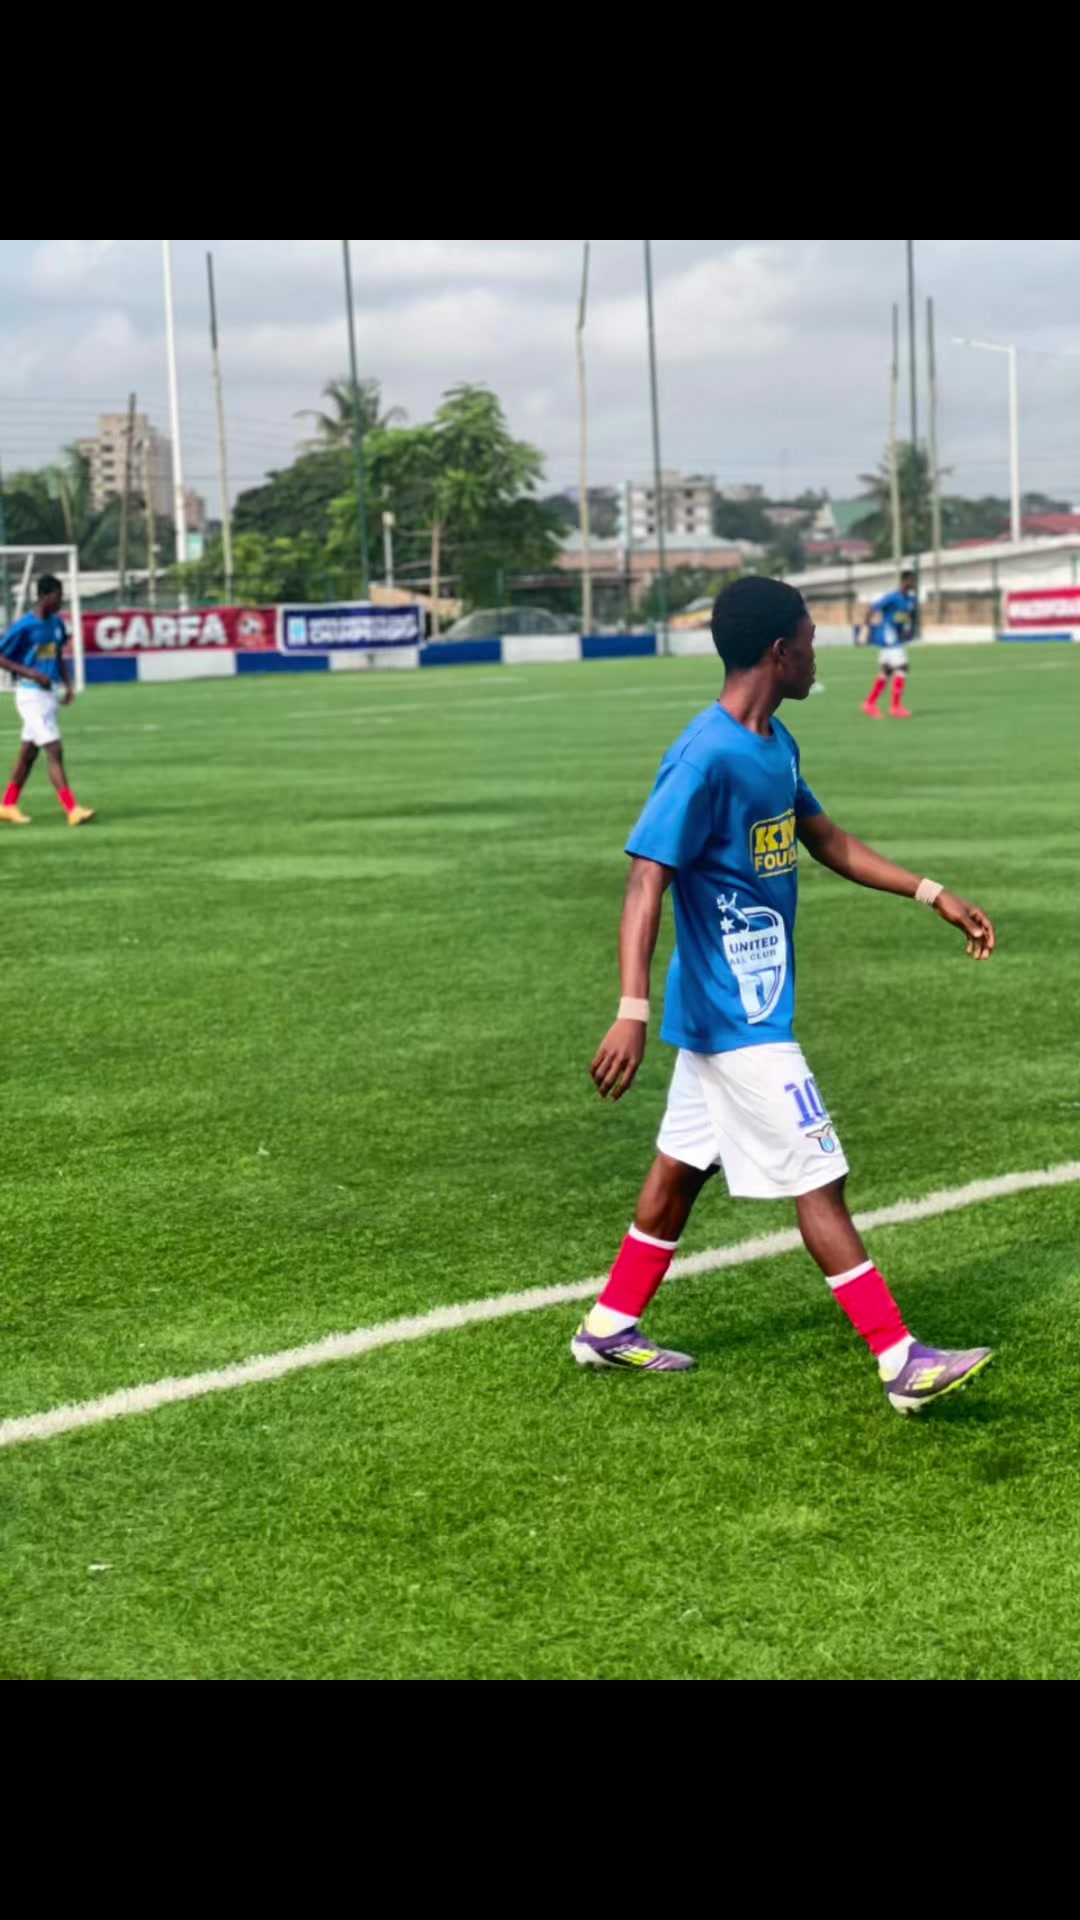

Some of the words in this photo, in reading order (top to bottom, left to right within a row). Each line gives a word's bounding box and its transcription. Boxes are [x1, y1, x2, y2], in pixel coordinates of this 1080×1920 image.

[95, 614, 228, 650] GARFA
[729, 935, 779, 954] UNITED
[750, 949, 777, 961] CLUB
[784, 1077, 828, 1128] 10
